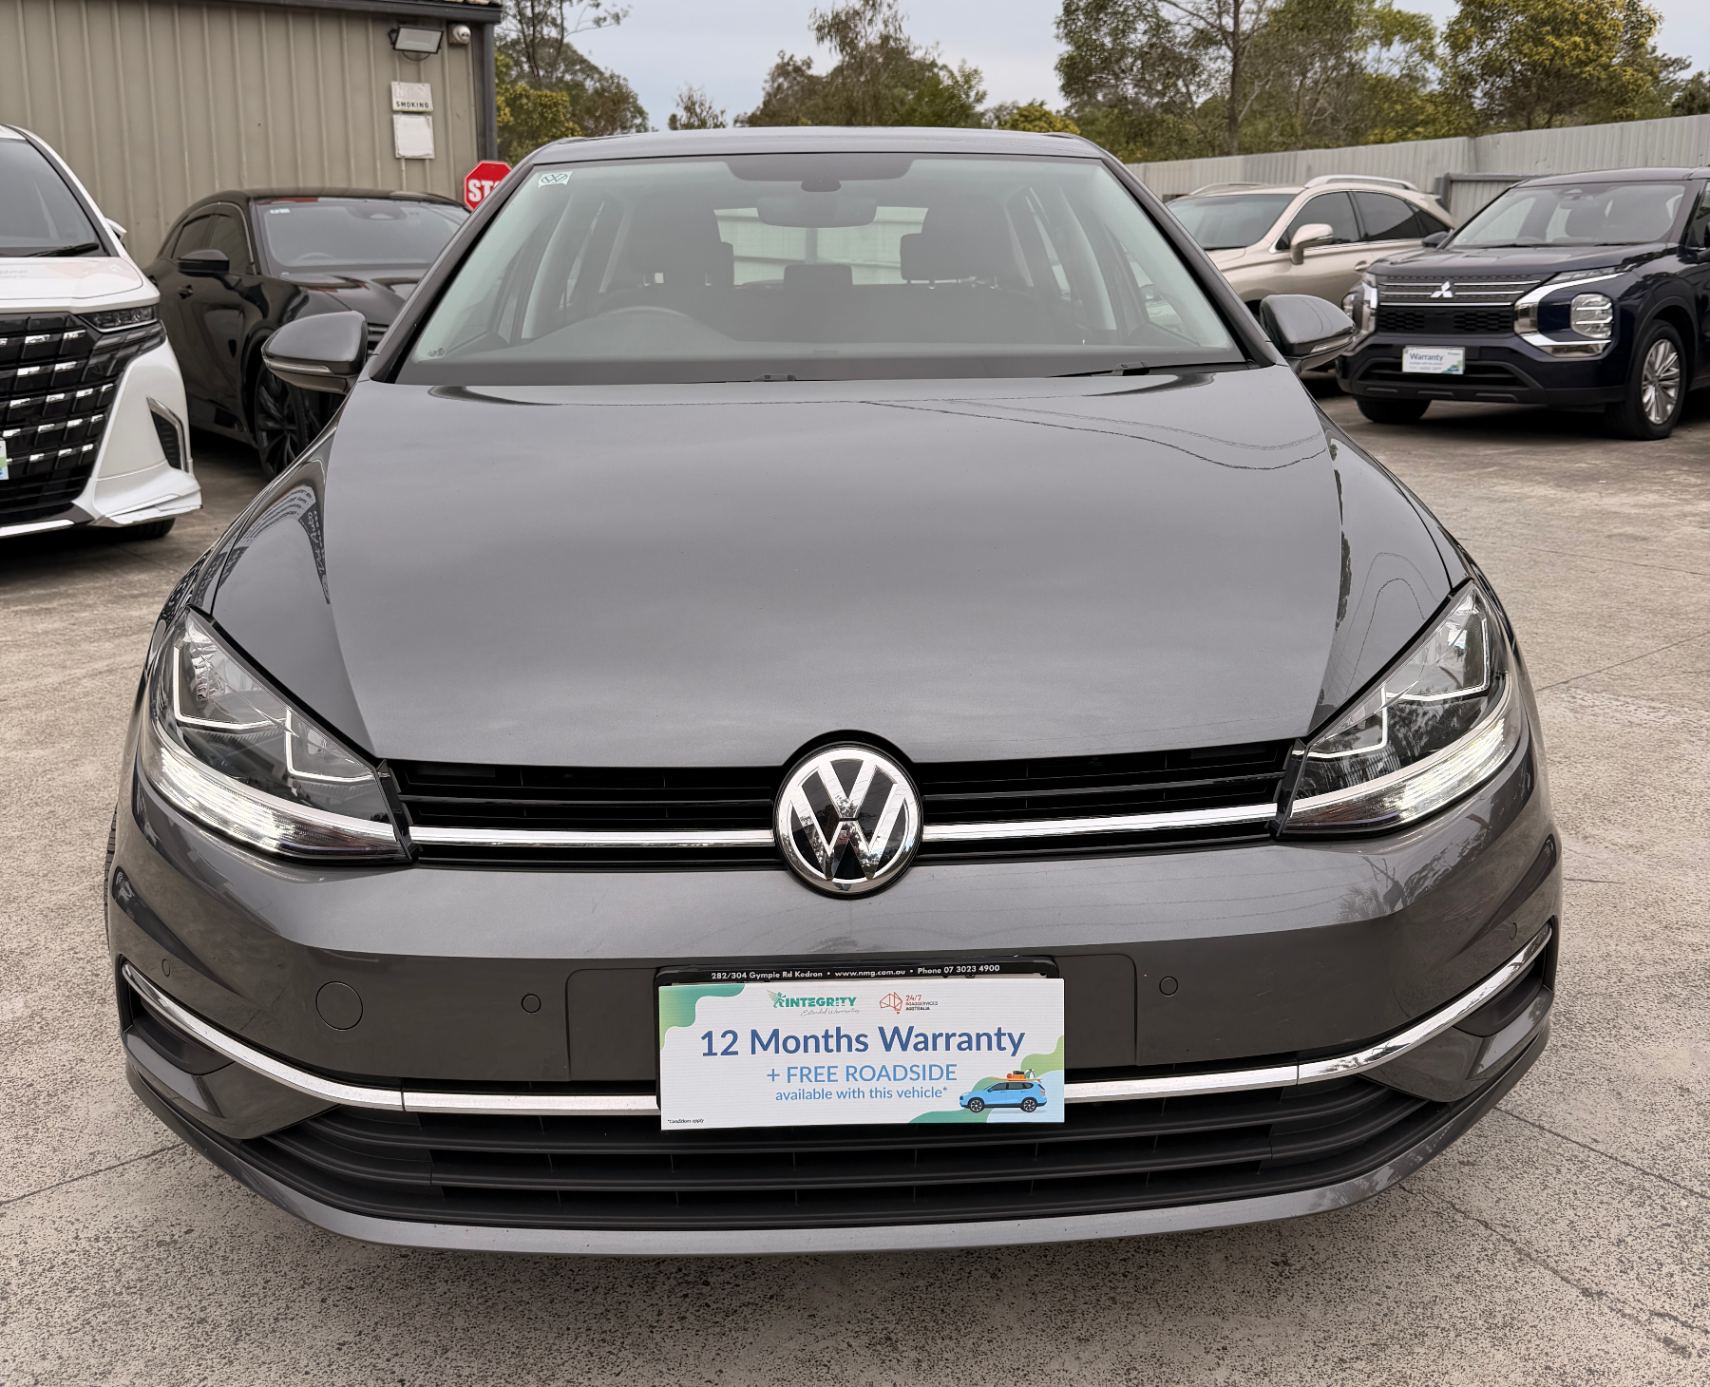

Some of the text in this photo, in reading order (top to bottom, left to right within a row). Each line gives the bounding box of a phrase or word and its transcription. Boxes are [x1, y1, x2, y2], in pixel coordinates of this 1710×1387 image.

[396, 101, 430, 109] SMOKING
[468, 178, 503, 203] ST
[711, 972, 747, 980] 282/304
[749, 971, 780, 981] Gympie
[795, 970, 823, 978] Kedron
[835, 969, 906, 978] www.nmg.com.au
[956, 965, 977, 973] 3023
[979, 964, 1000, 972] 4900
[785, 996, 857, 1008] INTEGRITY
[701, 1025, 1026, 1057] 12 Months Warranty
[766, 1064, 958, 1083] + FREE ROADSIDE
[775, 1087, 833, 1101] available
[836, 1087, 865, 1100] with
[869, 1086, 893, 1099] this
